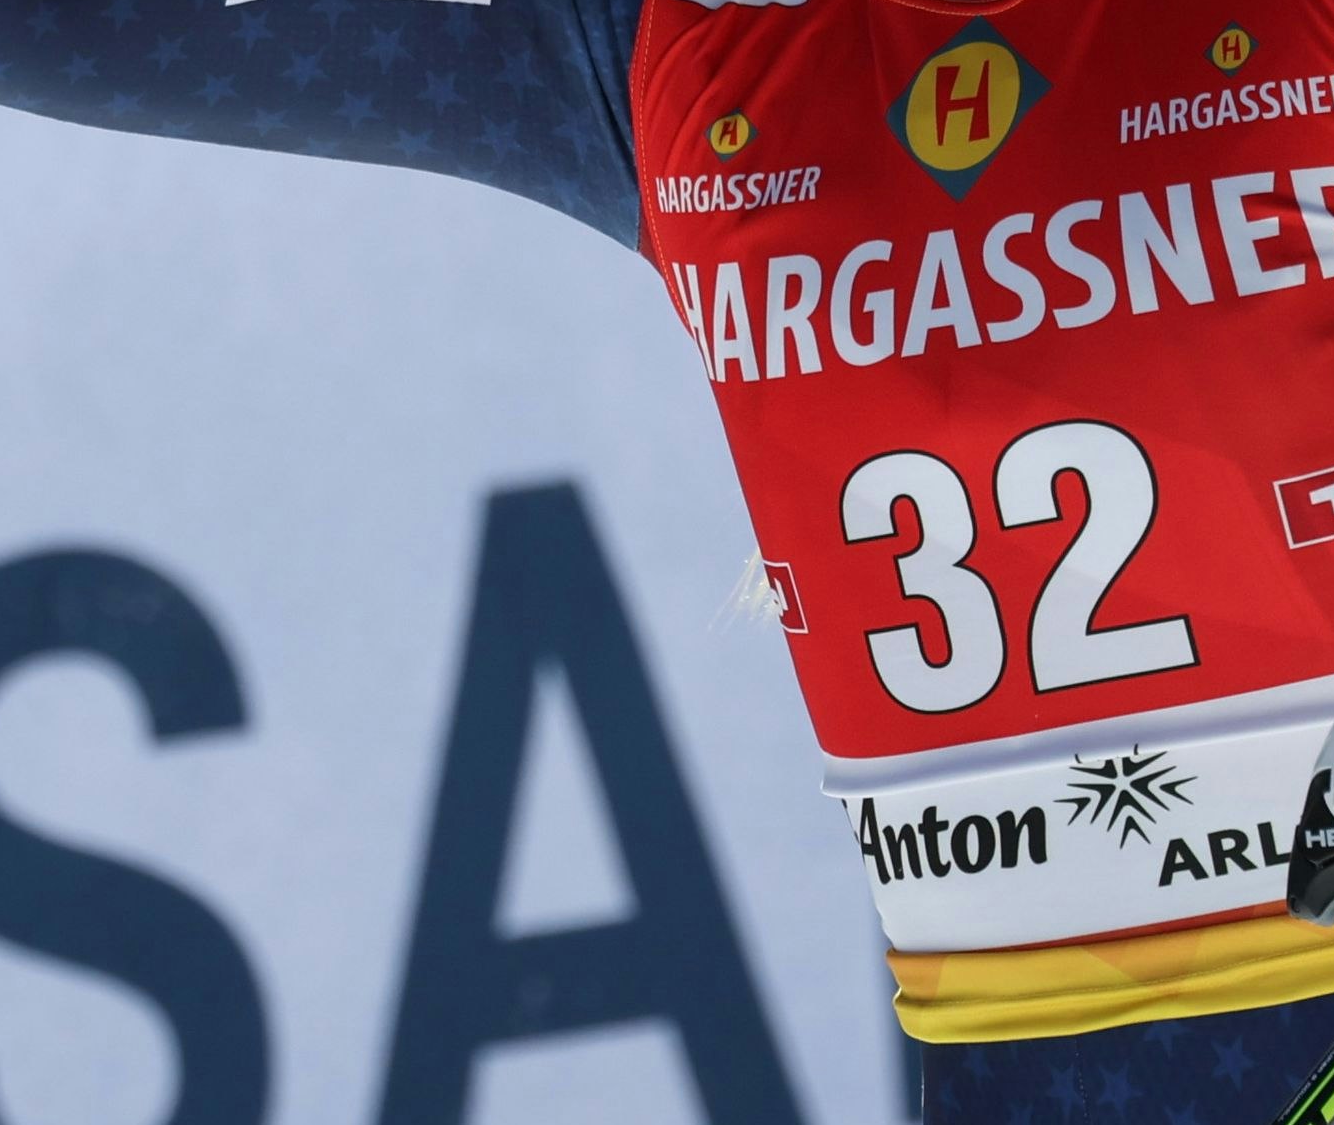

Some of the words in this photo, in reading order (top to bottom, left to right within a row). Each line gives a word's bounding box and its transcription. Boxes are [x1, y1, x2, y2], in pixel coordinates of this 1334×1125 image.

[655, 166, 821, 214] HARGASSNER
[839, 418, 1201, 715] 32
[859, 796, 1048, 886] Anton
